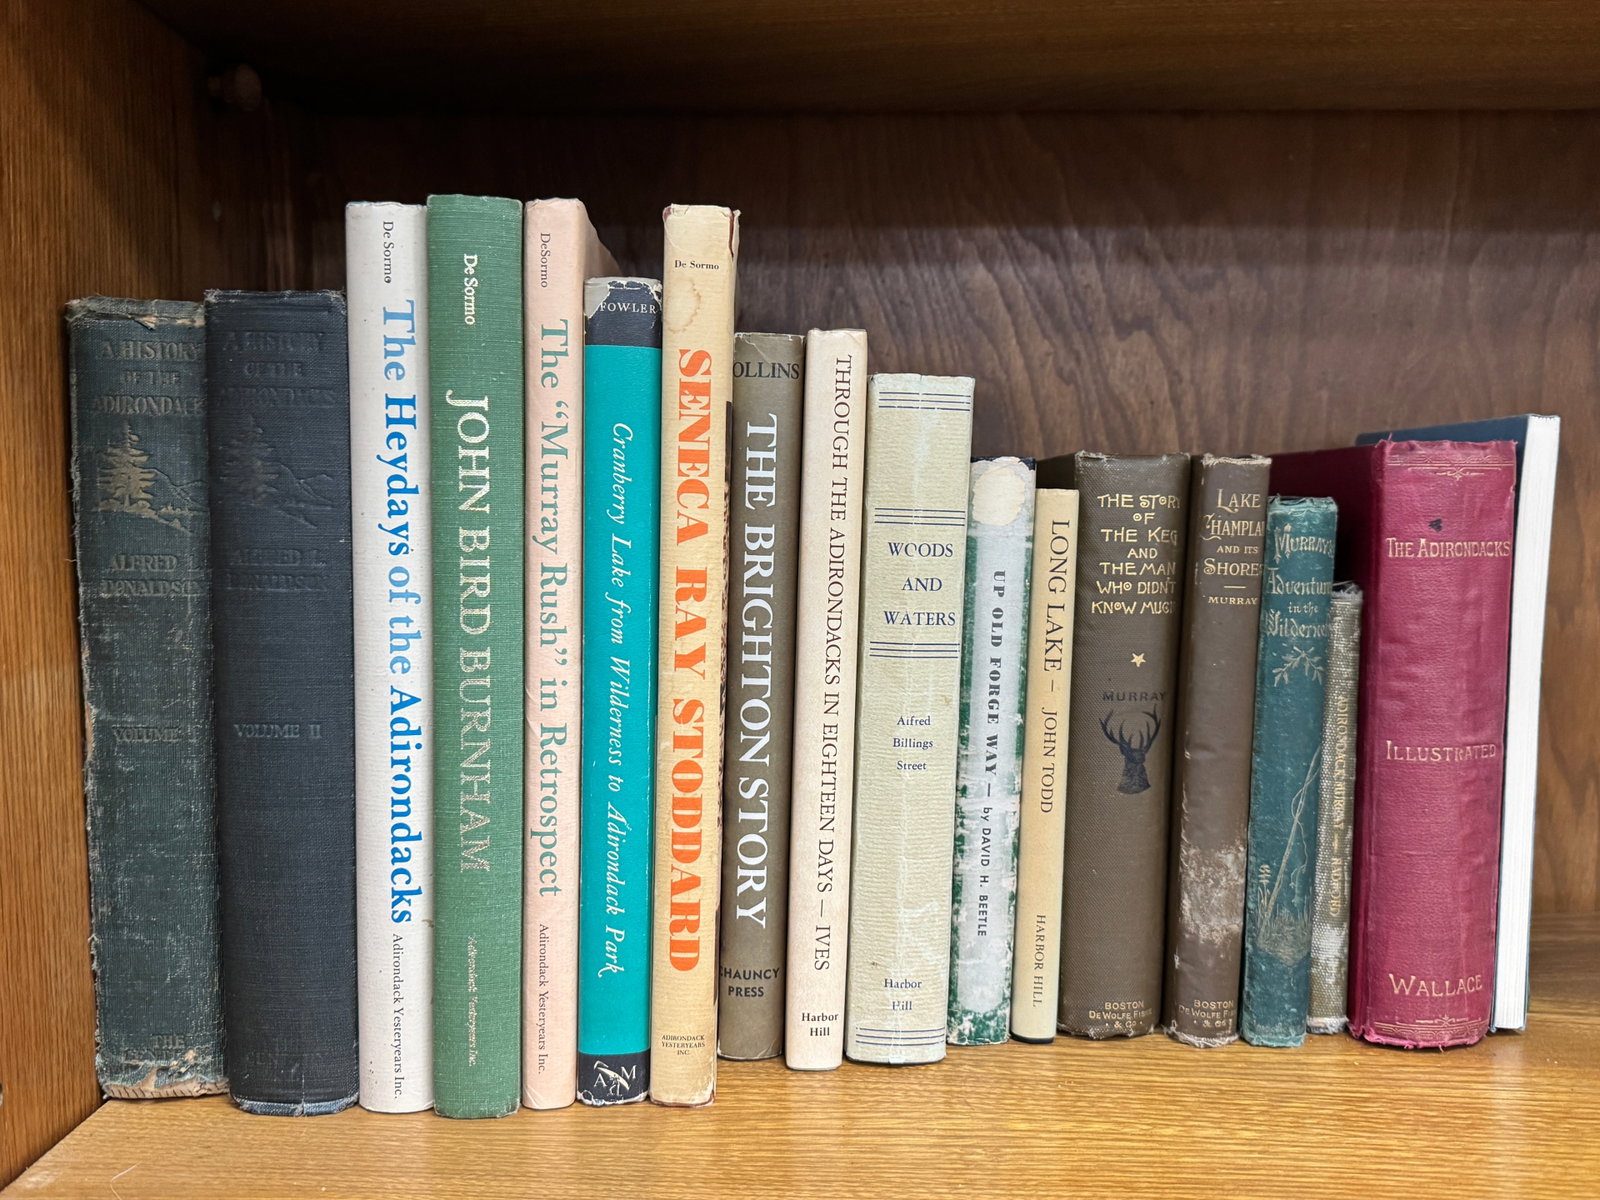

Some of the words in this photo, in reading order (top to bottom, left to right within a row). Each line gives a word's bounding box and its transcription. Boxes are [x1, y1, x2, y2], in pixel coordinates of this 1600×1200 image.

[383, 221, 394, 239] De
[383, 242, 395, 284] Sormo
[464, 254, 478, 275] De
[540, 233, 550, 288] DeSormo
[674, 260, 687, 268] De
[689, 261, 720, 270] Sormo
[464, 277, 479, 325] Sormo
[600, 300, 657, 314] FOWLER
[383, 299, 416, 381] The
[541, 319, 569, 389] The
[732, 361, 800, 380] OLLINS
[831, 355, 852, 470] THROUGH
[446, 389, 490, 514] JOHN
[676, 349, 712, 546] SENECA
[745, 413, 777, 510] THE
[376, 393, 420, 556] Heydays
[606, 421, 634, 525] Cranberry
[830, 477, 848, 521] THE
[1097, 493, 1134, 508] THE
[1133, 512, 1155, 525] OF
[1217, 488, 1261, 513] LAKE
[887, 542, 954, 558] WOODS
[1100, 526, 1138, 543] THE
[1148, 526, 1178, 546] KEG
[1127, 547, 1158, 559] AND
[1216, 545, 1240, 554] AND
[1243, 546, 1259, 554] ITS
[1417, 537, 1511, 557] ADIRONDACKS
[611, 533, 632, 588] Lake
[1048, 519, 1070, 595] LONG
[1099, 562, 1137, 575] THE
[1139, 562, 1177, 575] MAN
[388, 566, 422, 605] of
[459, 525, 490, 635] BIRD
[901, 577, 943, 593] AND
[993, 570, 1006, 598] UP
[1096, 580, 1133, 594] WHO
[605, 592, 632, 645] from
[824, 527, 846, 685] ADIRONDACKS
[884, 610, 956, 627] WATERS
[1091, 600, 1137, 614] KNOW
[1208, 596, 1258, 605] MURRAY
[1288, 602, 1301, 613] in
[1303, 601, 1318, 616] the
[674, 566, 707, 680] RAY
[991, 605, 1006, 649] OLD
[1043, 602, 1066, 673] LAKE
[389, 615, 422, 674] the
[738, 523, 775, 767] BRIGHTON
[540, 677, 568, 712] in
[824, 692, 840, 716] IN
[987, 656, 1002, 725] FORGE
[1102, 690, 1167, 702] MURRAY
[234, 723, 300, 739] VOLUME
[308, 723, 323, 739] II
[608, 656, 631, 766] Wilderness
[892, 737, 934, 751] Billings
[1041, 707, 1058, 758] JOHN
[1386, 740, 1497, 763] ILLUSTRATED
[459, 646, 491, 873] BURNHAM
[896, 760, 927, 772] Street
[984, 732, 999, 777] WAY
[608, 775, 624, 792] to
[819, 723, 838, 833] EIGHTEEN
[1040, 763, 1055, 814] TODD
[390, 685, 423, 924] Adirondacks
[530, 723, 568, 897] Retrospect
[981, 806, 992, 822] by
[669, 698, 705, 972] STODDARD
[736, 777, 769, 929] STORY
[980, 827, 992, 867] DAVID
[606, 801, 632, 916] Adirondack
[817, 839, 834, 893] DAYS
[979, 875, 990, 889] H.
[977, 894, 989, 938] BEETLE
[539, 923, 550, 988] Adirondack
[598, 925, 625, 978] Park
[814, 925, 831, 971] IVES
[1034, 914, 1046, 972] HARBOR
[392, 933, 404, 1004] Adirondack
[883, 978, 923, 990] Harbor
[1388, 973, 1483, 997] WALLACE
[728, 985, 764, 998] PRESS
[891, 1000, 913, 1012] Hill
[1032, 975, 1044, 1008] HILL
[1105, 1001, 1145, 1010] BOSTON
[1193, 1000, 1234, 1010] BOSTON
[536, 990, 549, 1051] Yesteryears
[801, 1011, 839, 1023] Harbor
[810, 1025, 831, 1037] Hill
[391, 1007, 405, 1074] Yesteryears
[538, 1054, 548, 1076] Inc.
[393, 1076, 404, 1099] Inc.
